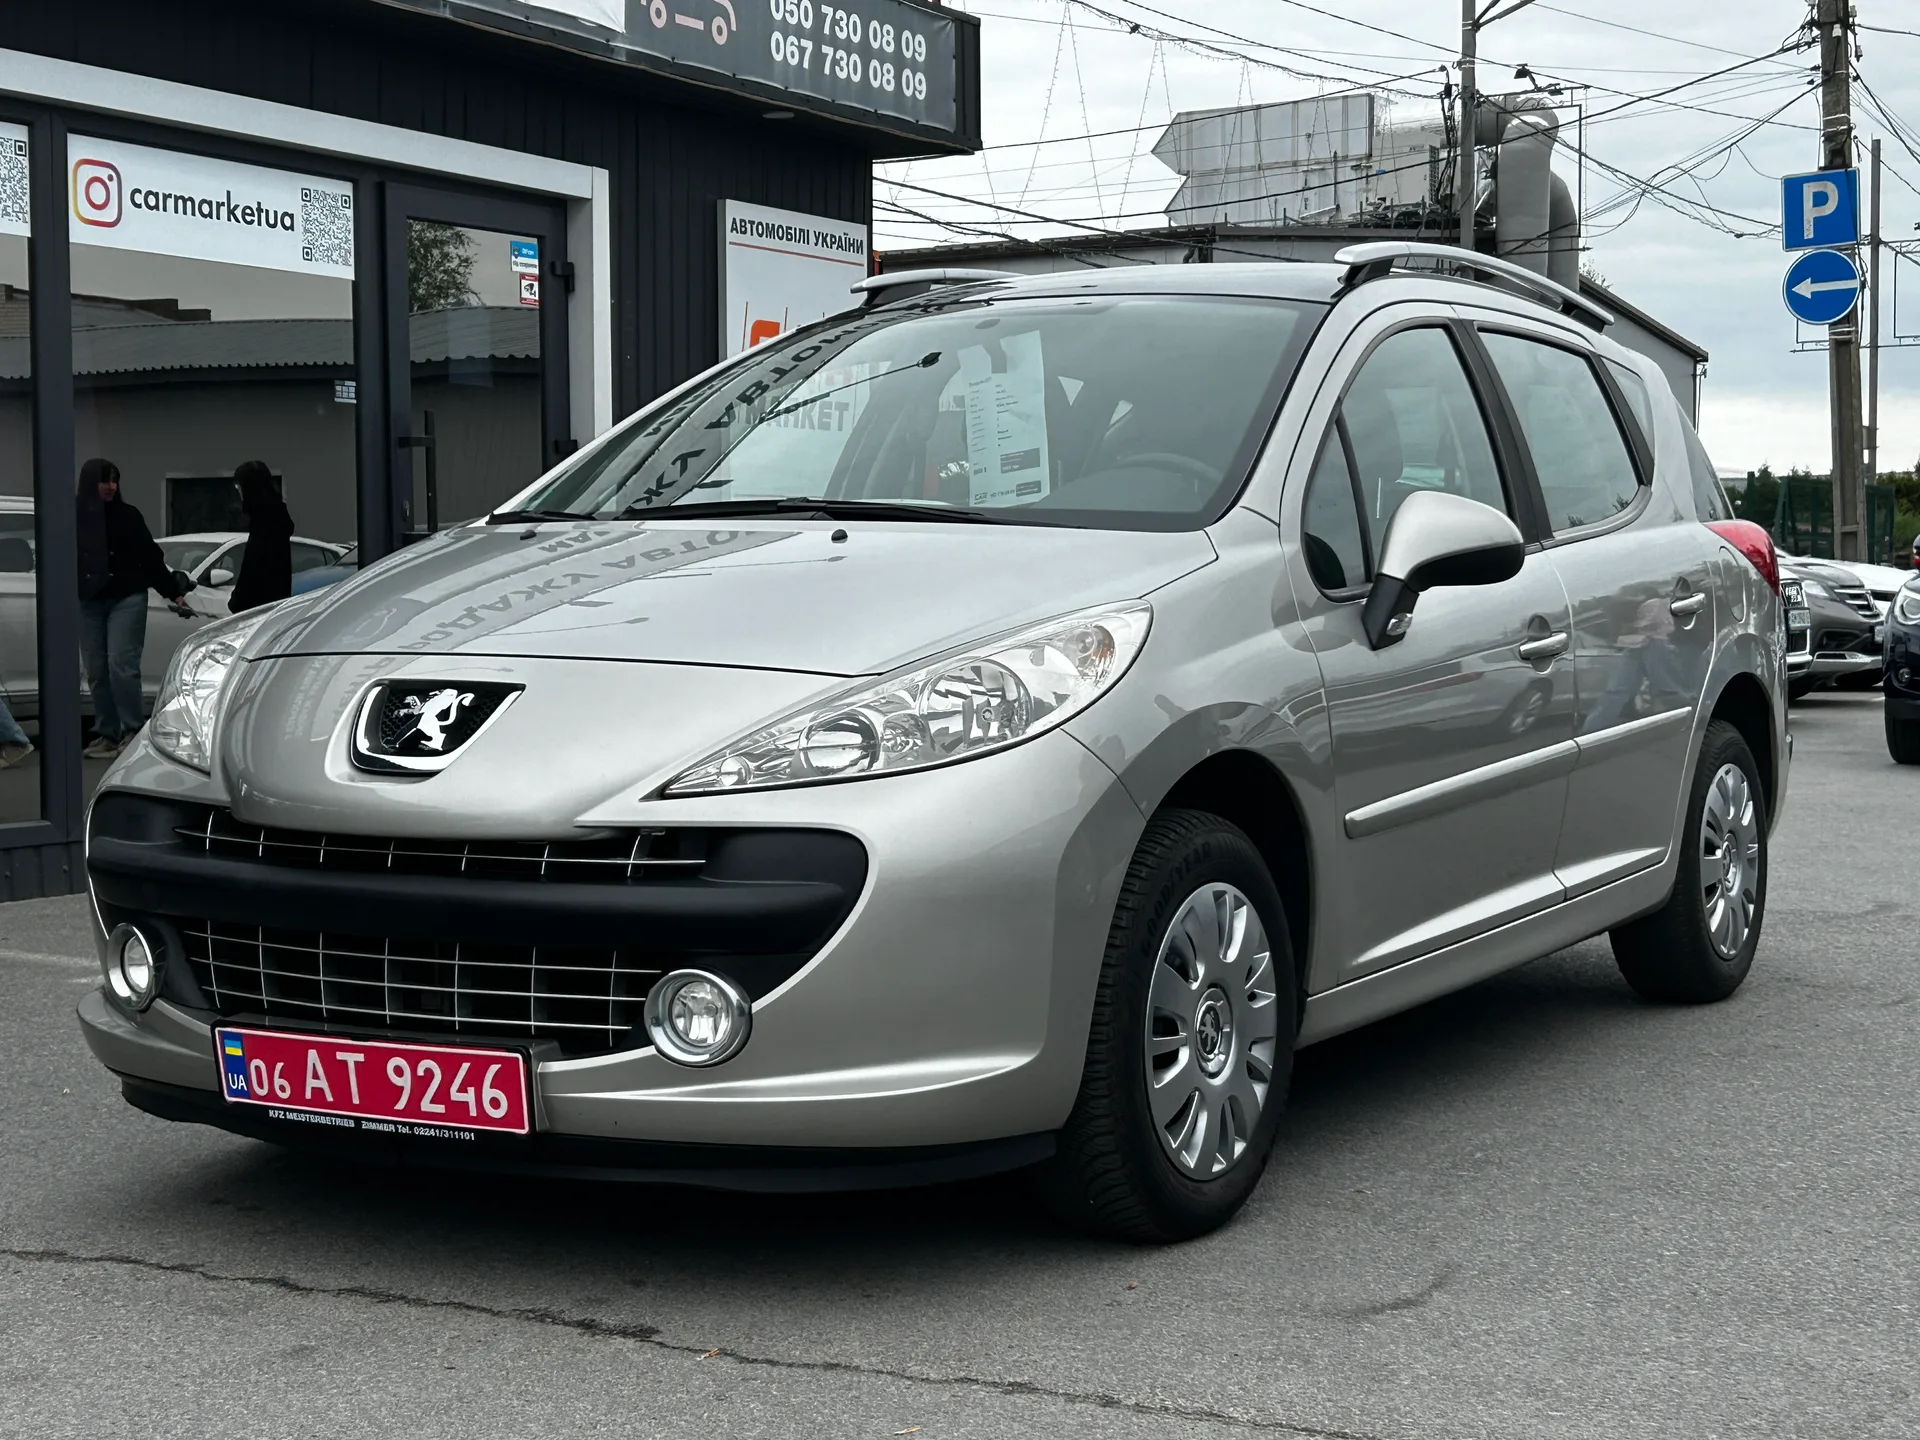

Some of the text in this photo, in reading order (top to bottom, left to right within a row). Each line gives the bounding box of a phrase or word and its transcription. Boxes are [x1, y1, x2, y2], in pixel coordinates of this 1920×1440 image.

[770, 0, 926, 62] 050 730 08 09
[771, 31, 927, 100] 067 730 08 09
[130, 188, 295, 231] carmarketua
[1803, 181, 1838, 239] P
[730, 217, 864, 255] АВТОМОБІЛІ УКРАЇНИ
[229, 1073, 247, 1091] UA
[250, 1049, 508, 1119] 06 AT 9246
[268, 1109, 285, 1119] KFZ
[414, 1126, 475, 1141] 02241/311101
